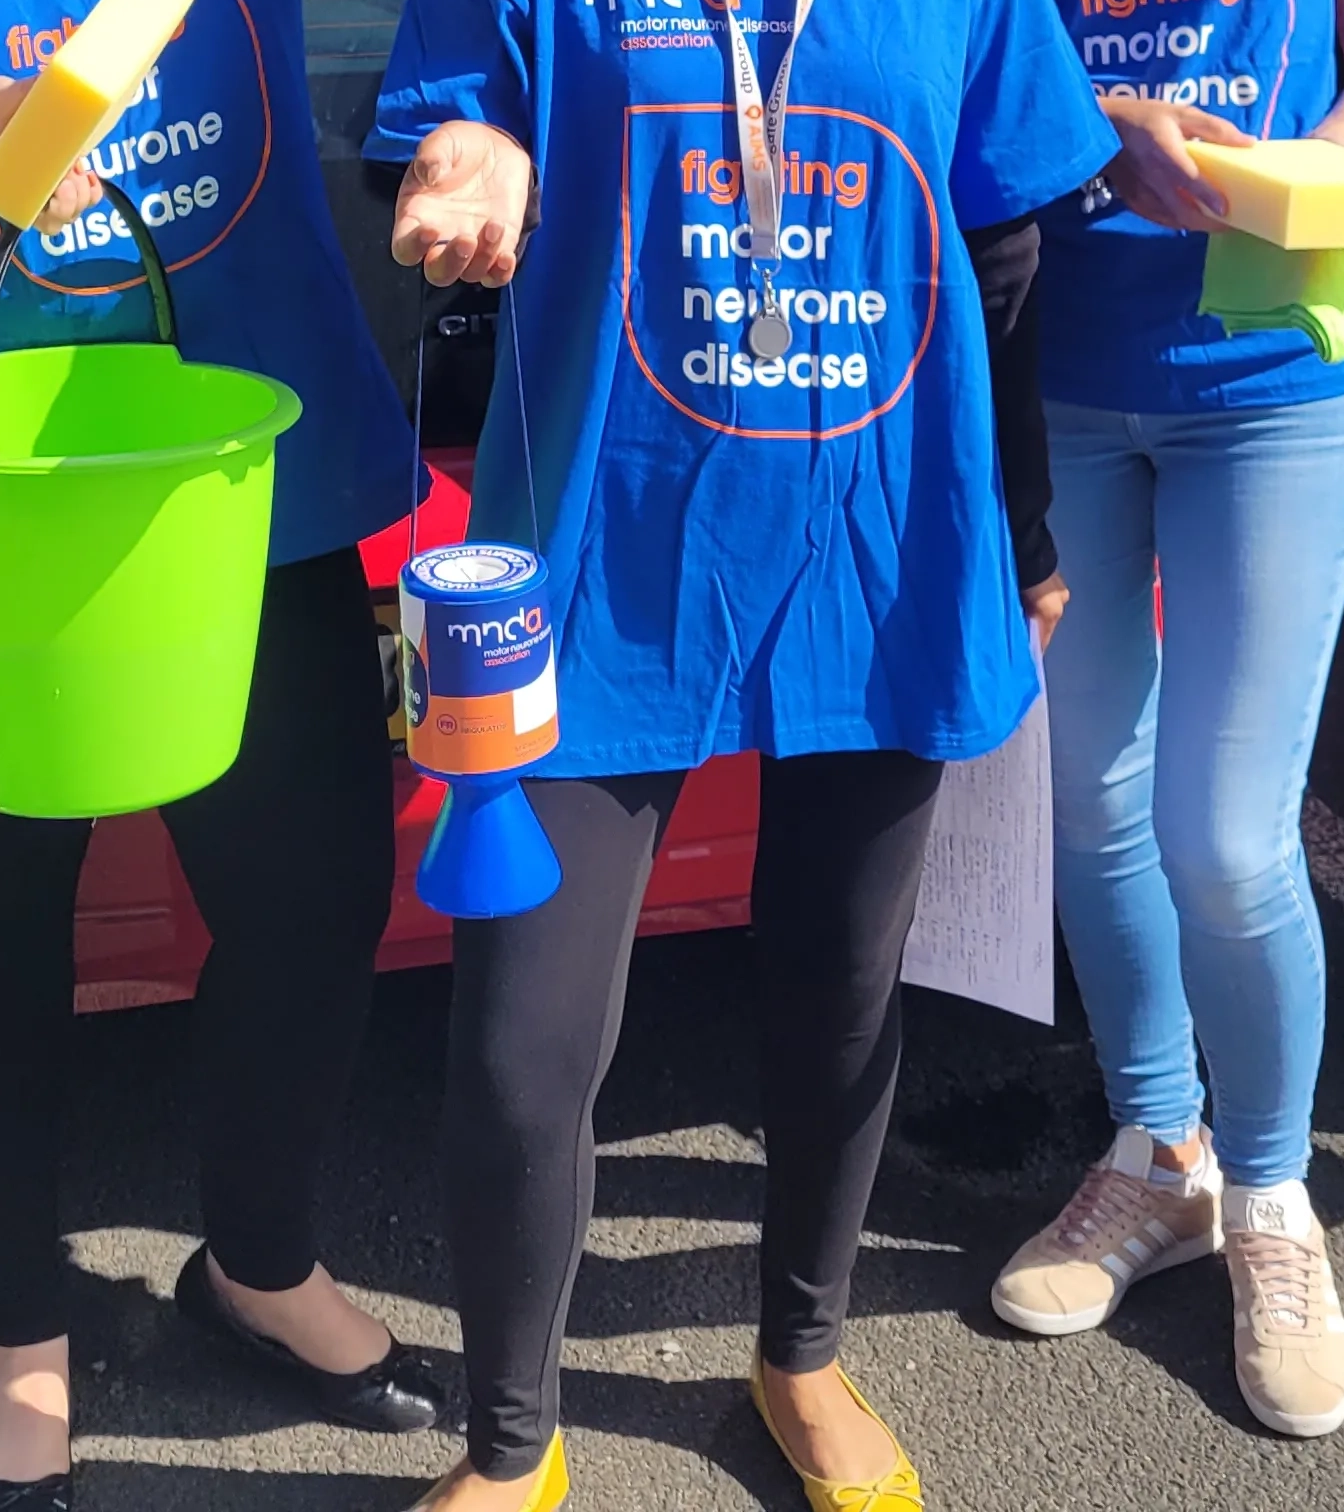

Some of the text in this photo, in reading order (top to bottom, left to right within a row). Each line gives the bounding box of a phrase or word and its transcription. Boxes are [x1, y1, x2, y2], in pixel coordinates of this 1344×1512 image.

[621, 16, 668, 33] motor
[738, 18, 795, 34] disease
[621, 33, 714, 51] association
[1083, 21, 1214, 66] motor
[1092, 74, 1260, 106] eurone
[79, 111, 223, 178] urone
[748, 125, 766, 171] AIMS
[681, 149, 868, 208] figting
[682, 223, 833, 260] moor
[682, 343, 868, 388] disease
[448, 607, 542, 647] mnda
